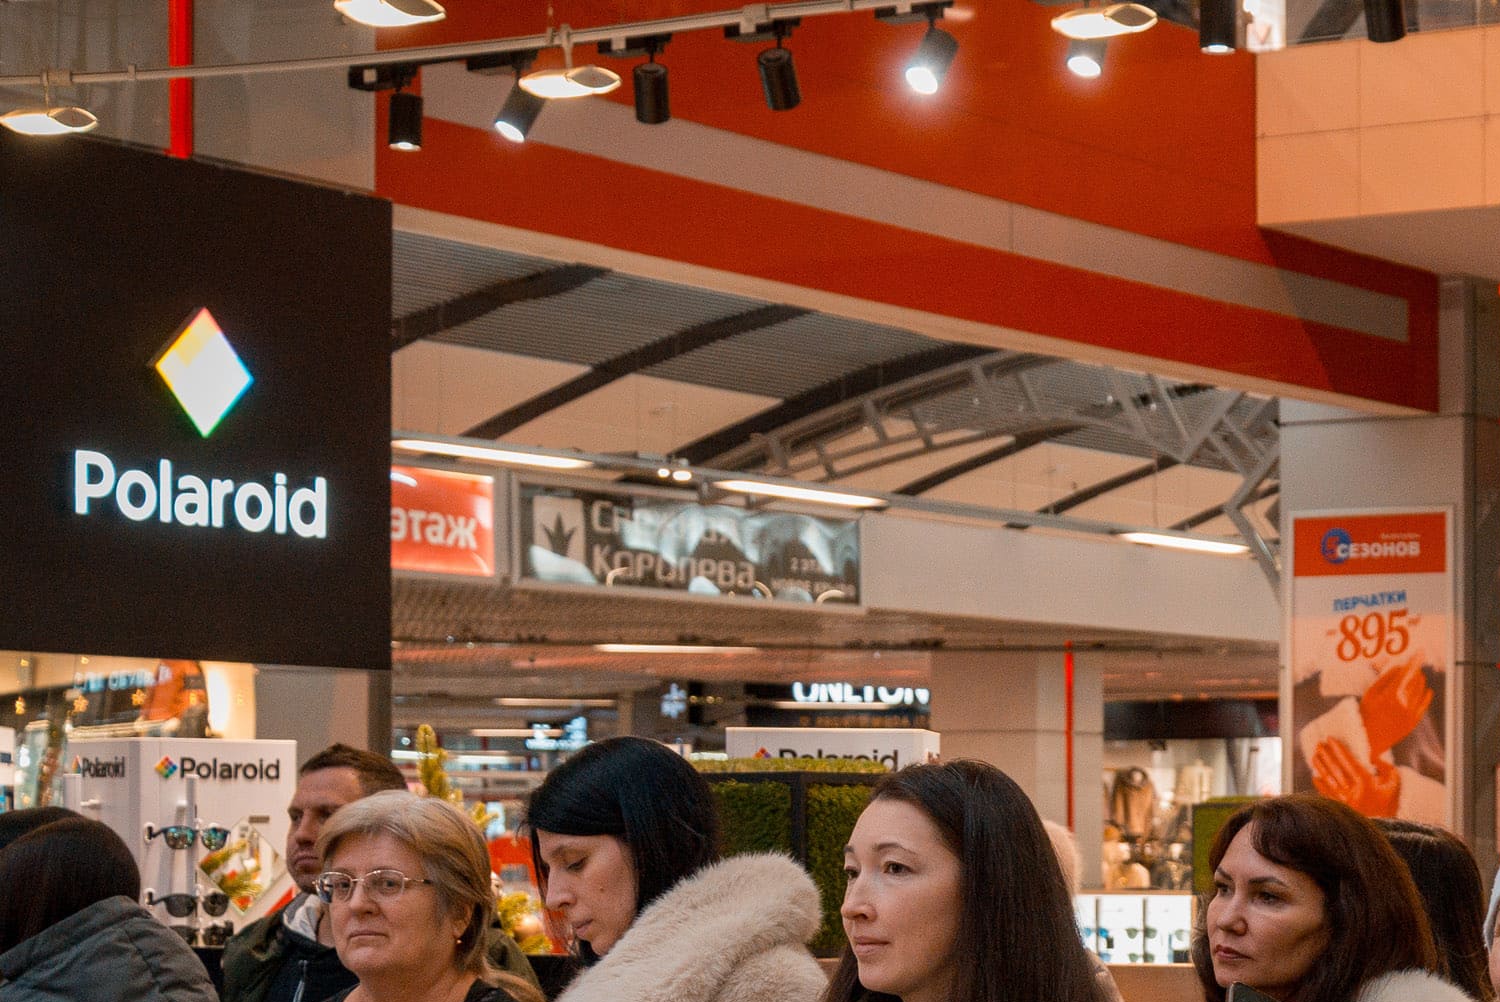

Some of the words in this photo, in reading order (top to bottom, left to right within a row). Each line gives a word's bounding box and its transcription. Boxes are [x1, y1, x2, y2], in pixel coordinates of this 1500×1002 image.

[75, 449, 327, 539] Polaroid
[391, 506, 478, 551] этаж
[1333, 589, 1407, 612] ПЕРЧАТКИ
[1337, 608, 1409, 662] 895
[82, 756, 126, 779] Polaroid
[179, 756, 281, 781] Polaroid
